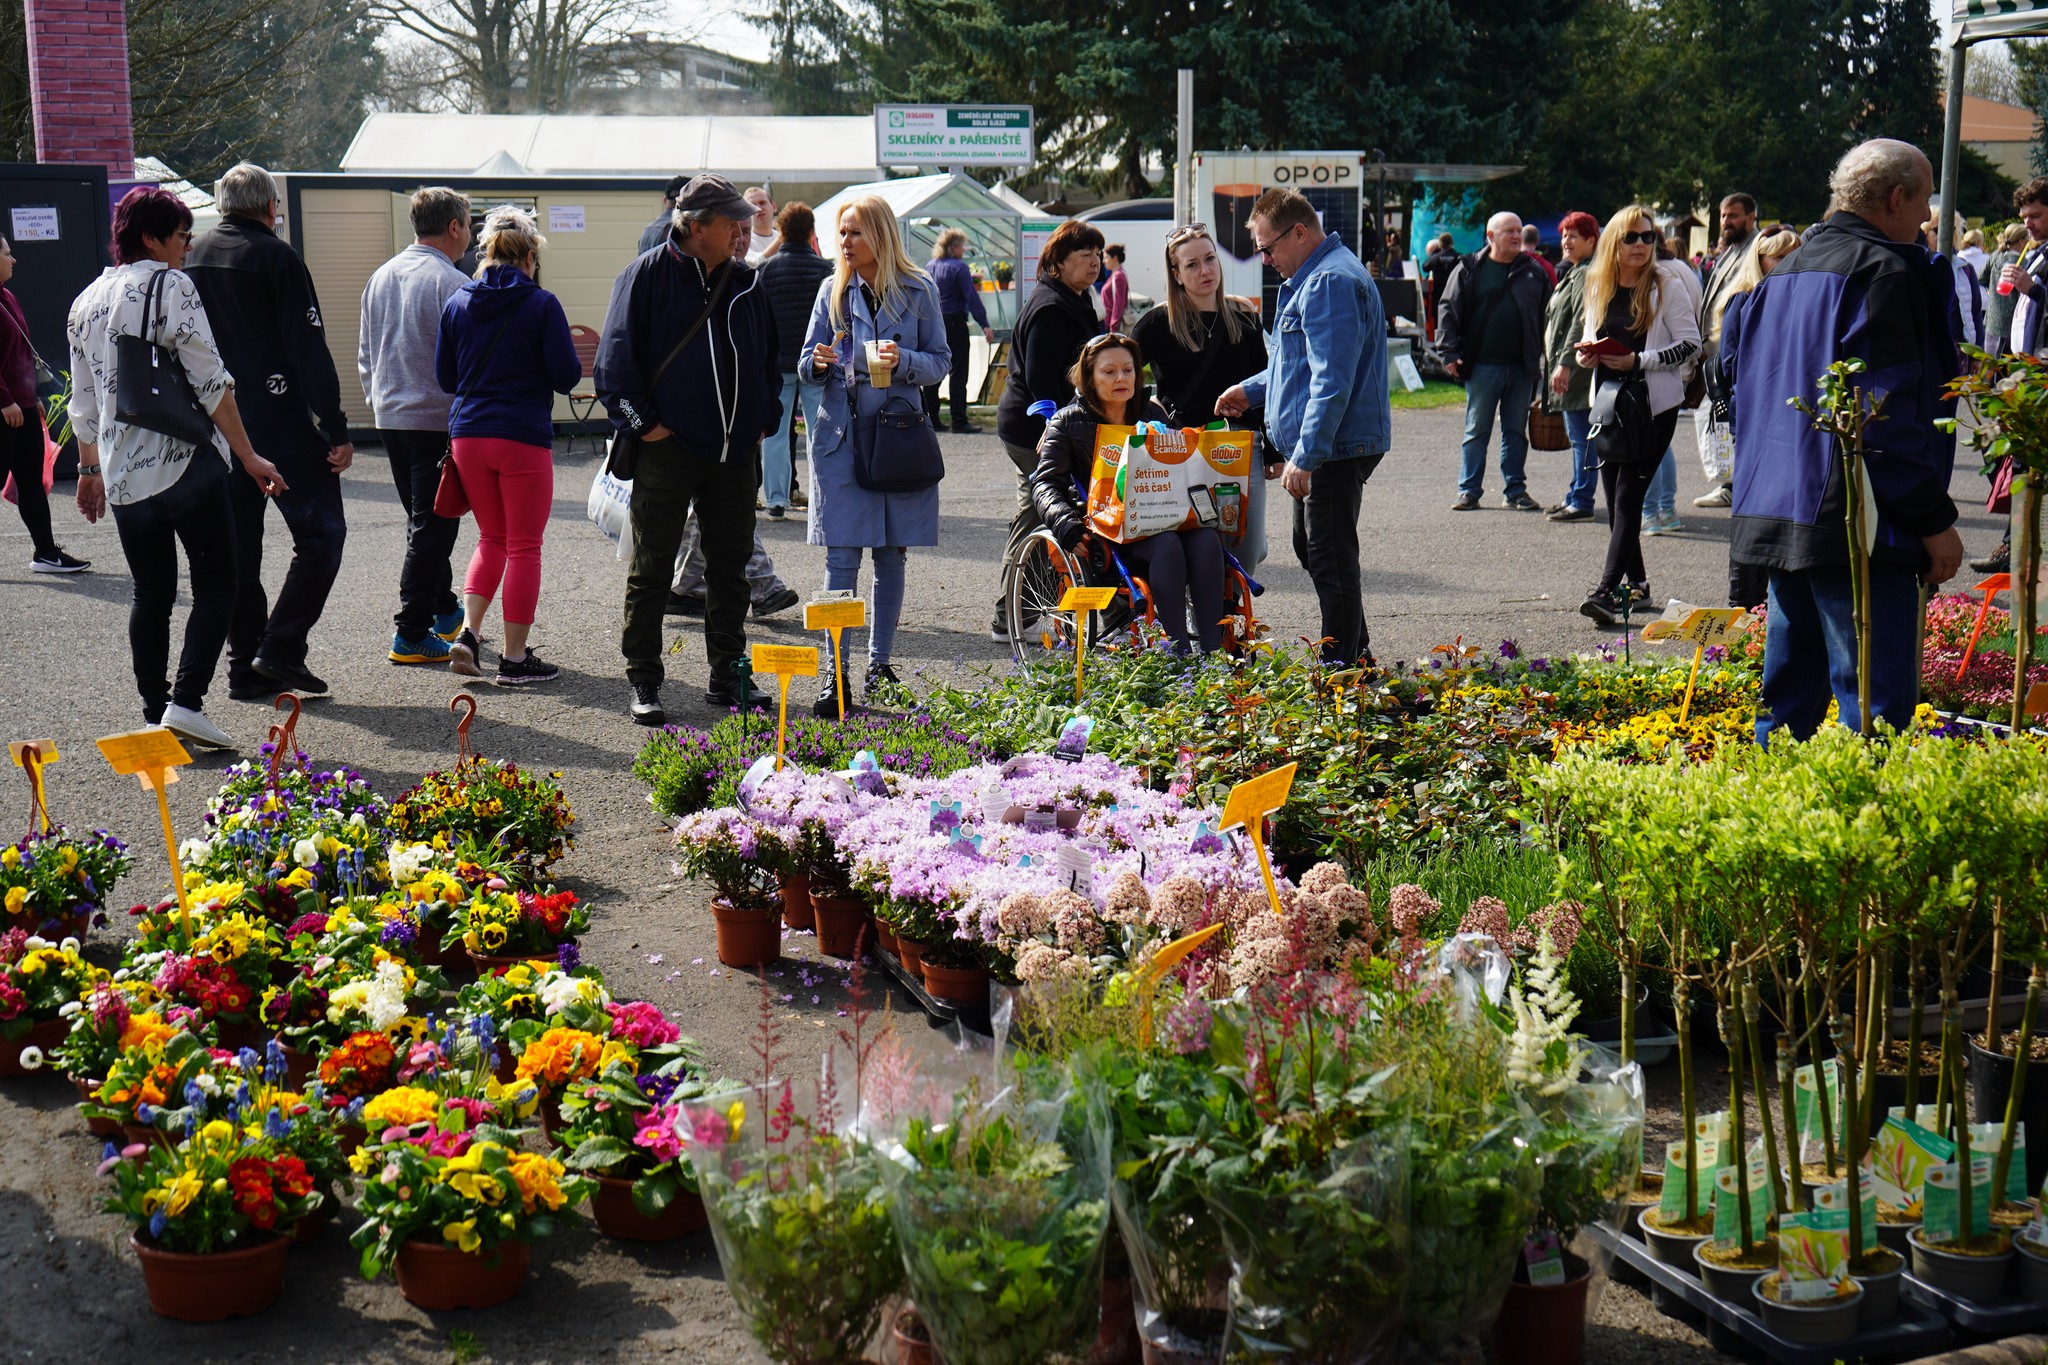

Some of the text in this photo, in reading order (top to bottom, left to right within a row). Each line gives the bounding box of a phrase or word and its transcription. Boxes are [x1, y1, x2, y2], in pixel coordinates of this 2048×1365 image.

[888, 132, 1021, 144] SKLENÍKY a PAŘENIŠTĚ
[1274, 166, 1350, 183] OPOP
[121, 438, 194, 472] Love Wins
[1154, 446, 1188, 454] Scan&Go
[1134, 467, 1169, 479] Šetříme
[1134, 482, 1172, 493] váš čas!
